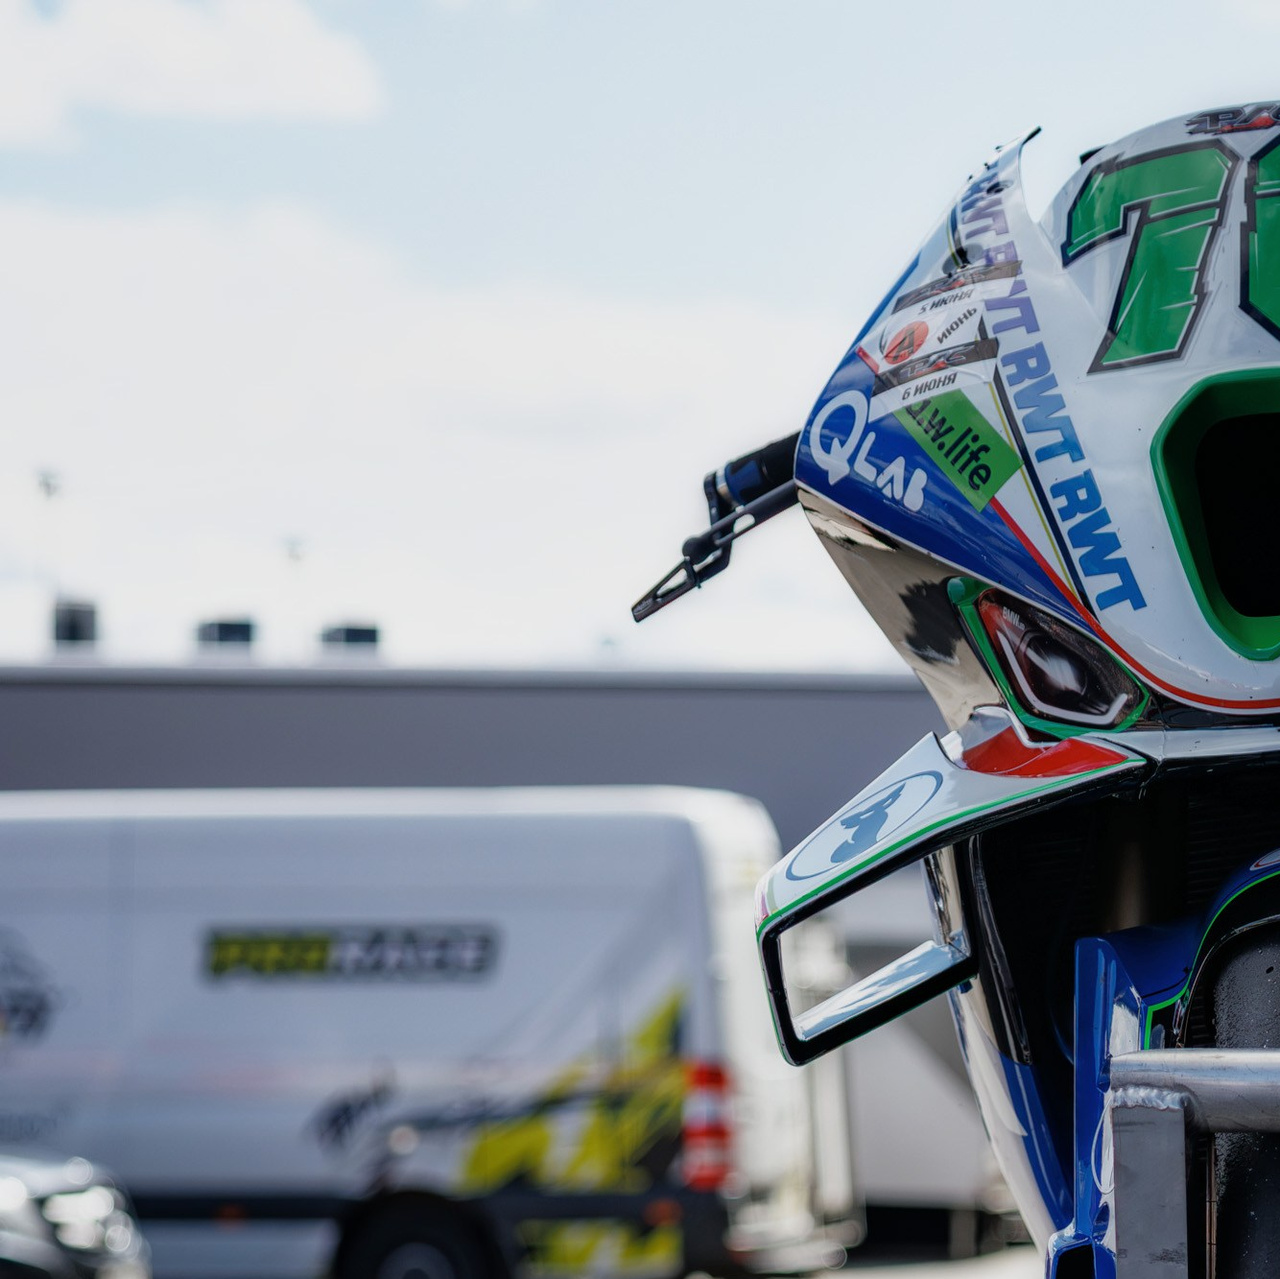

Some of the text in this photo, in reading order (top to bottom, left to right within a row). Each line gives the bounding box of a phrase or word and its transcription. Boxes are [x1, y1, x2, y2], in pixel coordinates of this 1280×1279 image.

[937, 308, 977, 344] ИЮНЬ
[902, 372, 958, 401] 6 ИЮНЯ
[1000, 341, 1086, 463] RWT
[1049, 467, 1147, 611] RWT
